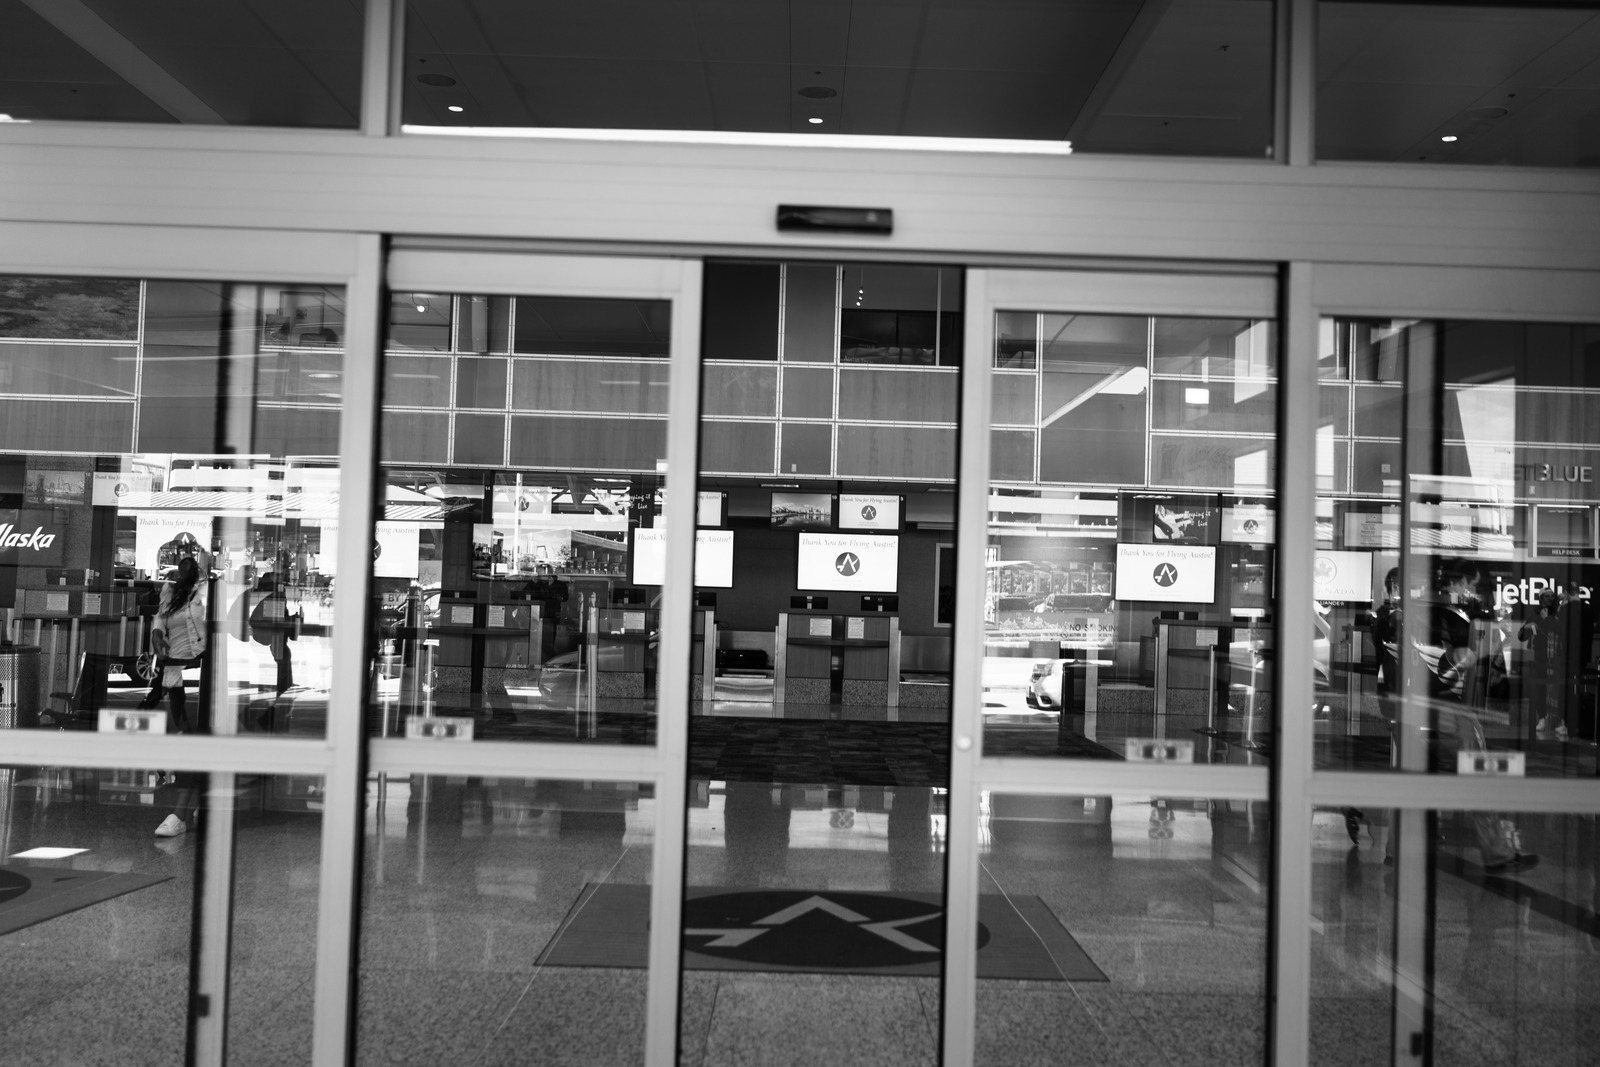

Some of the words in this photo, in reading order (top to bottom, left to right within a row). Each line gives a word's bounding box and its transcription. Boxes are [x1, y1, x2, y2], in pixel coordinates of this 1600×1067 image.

[138, 517, 159, 526] Thank
[161, 518, 174, 526] You
[174, 519, 184, 528] for
[186, 519, 207, 528] Flying
[392, 527, 417, 535] Austin!
[637, 533, 657, 541] Thank
[708, 535, 731, 543] Austin!
[802, 538, 822, 546] Thank
[824, 539, 837, 547] You
[837, 539, 847, 548] for
[849, 540, 870, 549] Flying
[872, 540, 896, 549] Austin!
[1120, 548, 1140, 556] Thank
[1142, 549, 1154, 557] You
[1154, 550, 1165, 559] for
[1167, 550, 1188, 560] Flying
[1189, 551, 1214, 559] Austin!
[1069, 623, 1082, 632] NO
